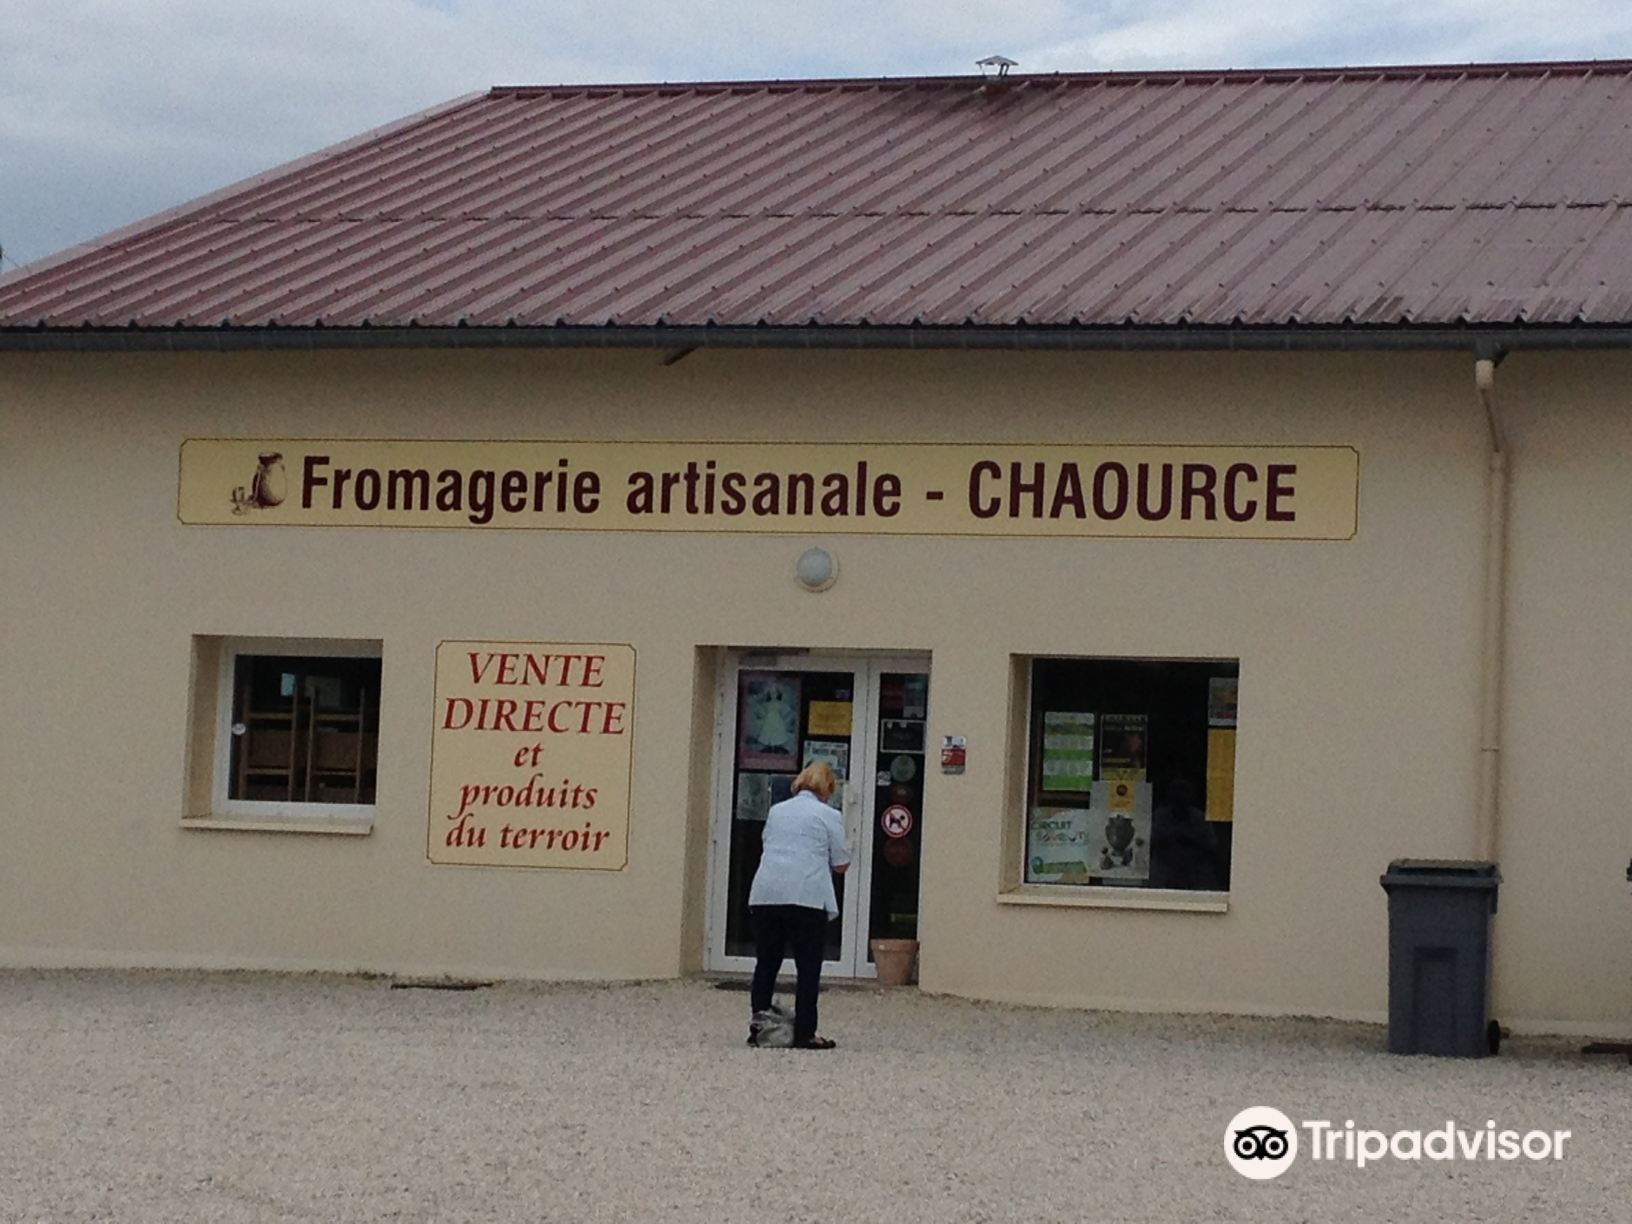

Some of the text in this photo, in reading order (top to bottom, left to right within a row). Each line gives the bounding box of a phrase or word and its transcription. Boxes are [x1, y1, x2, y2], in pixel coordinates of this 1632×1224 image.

[302, 455, 1298, 525] Fromagerie artisanale - CHAOURCE
[467, 652, 606, 688] VENTE
[441, 697, 627, 735] DIRECTE
[513, 742, 545, 768] et
[447, 772, 599, 820] produits
[445, 812, 611, 853] du terroir
